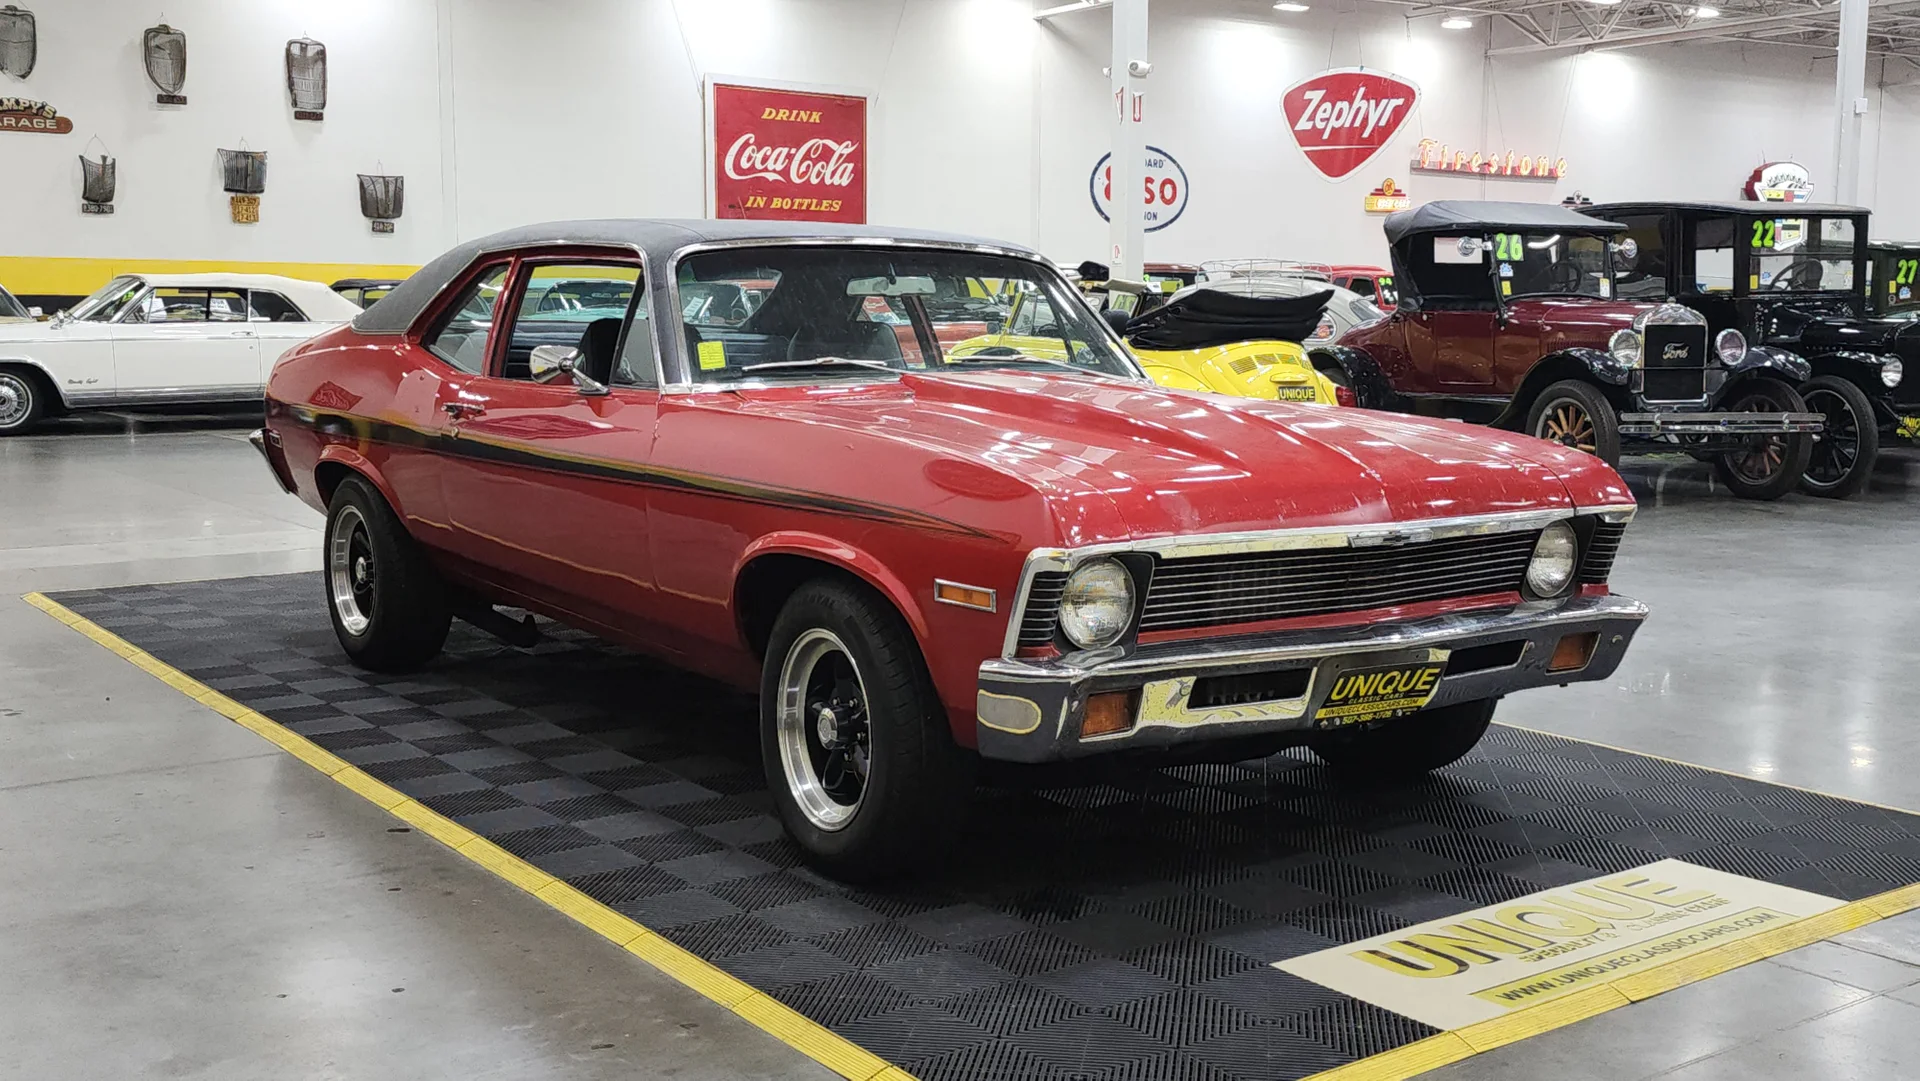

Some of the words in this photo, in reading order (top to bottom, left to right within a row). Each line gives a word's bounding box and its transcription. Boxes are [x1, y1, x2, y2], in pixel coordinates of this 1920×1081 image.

[0, 97, 57, 119] MPY'S
[761, 107, 823, 123] DRINK
[1293, 86, 1405, 140] Zephyr
[0, 117, 58, 129] RAGE
[724, 133, 859, 187] Coca-Cola
[1418, 138, 1568, 179] Firestone
[745, 195, 767, 208] IN
[770, 197, 842, 212] BOTTLES
[1496, 232, 1523, 260] 26
[1751, 220, 1775, 248] 22
[1896, 259, 1918, 284] 27
[1662, 342, 1690, 360] Ford
[1279, 387, 1315, 399] UNIQUE
[1330, 667, 1441, 700] UNIQUE
[1323, 698, 1420, 716] UNIQUECLASSICCARS.COM
[1348, 694, 1383, 705] CLASSIC
[1384, 692, 1404, 700] CARS
[1347, 874, 1717, 979] UNIQUE
[1496, 912, 1781, 1001] WWW.UNIQUECLASSICCARS.COM
